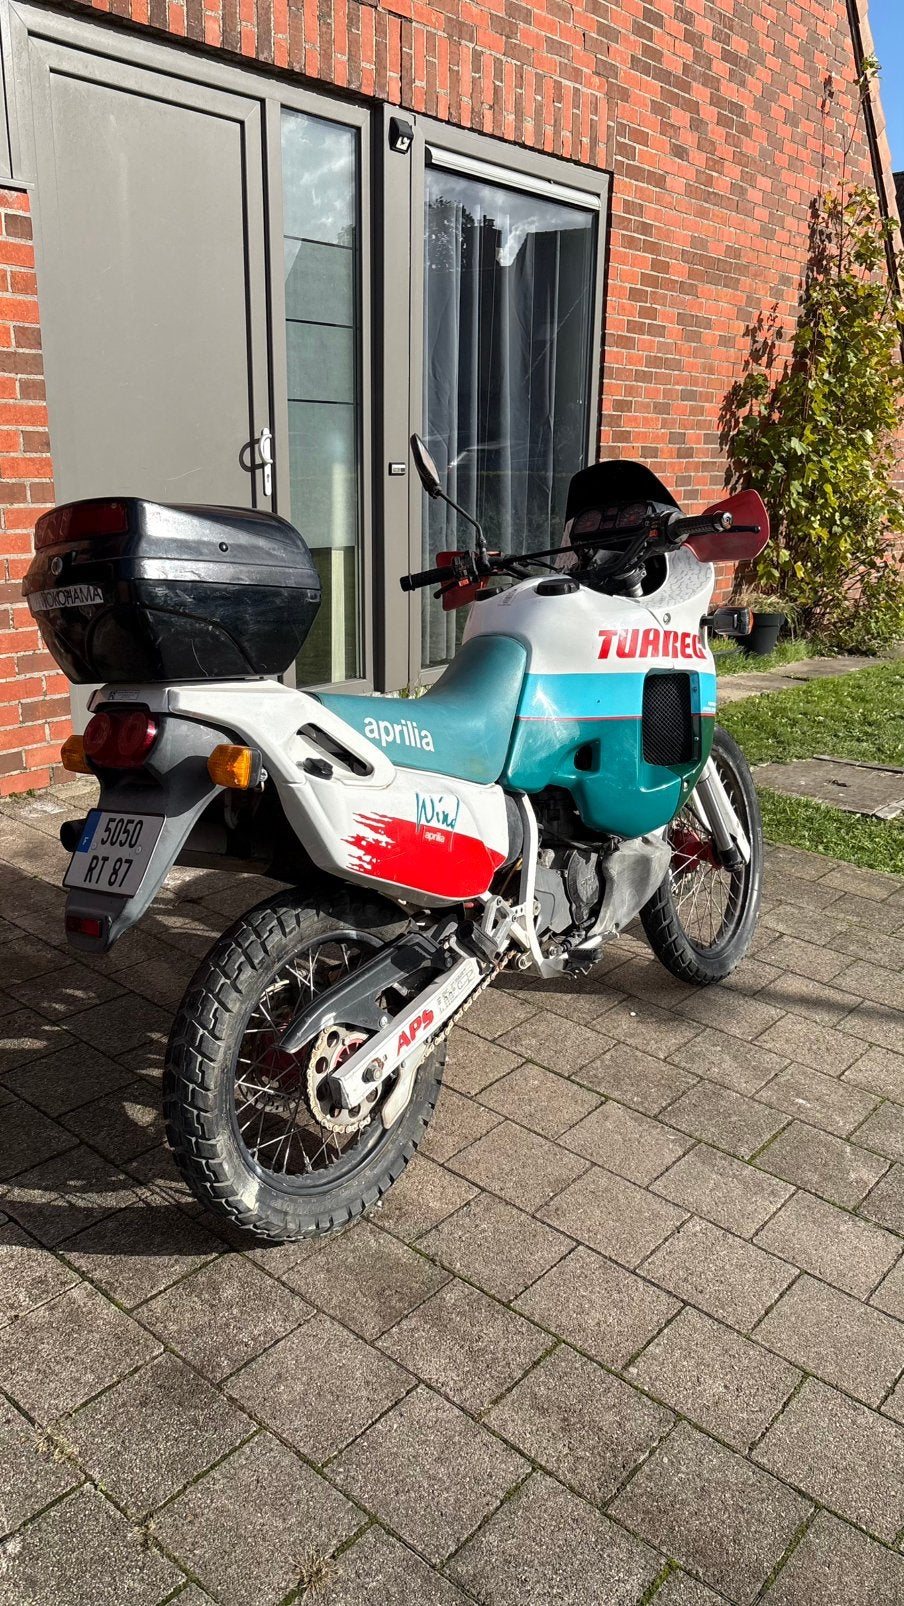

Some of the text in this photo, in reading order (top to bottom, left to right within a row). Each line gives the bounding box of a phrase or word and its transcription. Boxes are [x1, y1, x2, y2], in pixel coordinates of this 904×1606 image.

[363, 717, 435, 752] aprilia
[101, 817, 143, 848] 5050
[415, 791, 460, 853] Wind
[424, 831, 446, 843] aprilia
[84, 855, 133, 887] RT 87
[397, 1009, 434, 1057] APS
